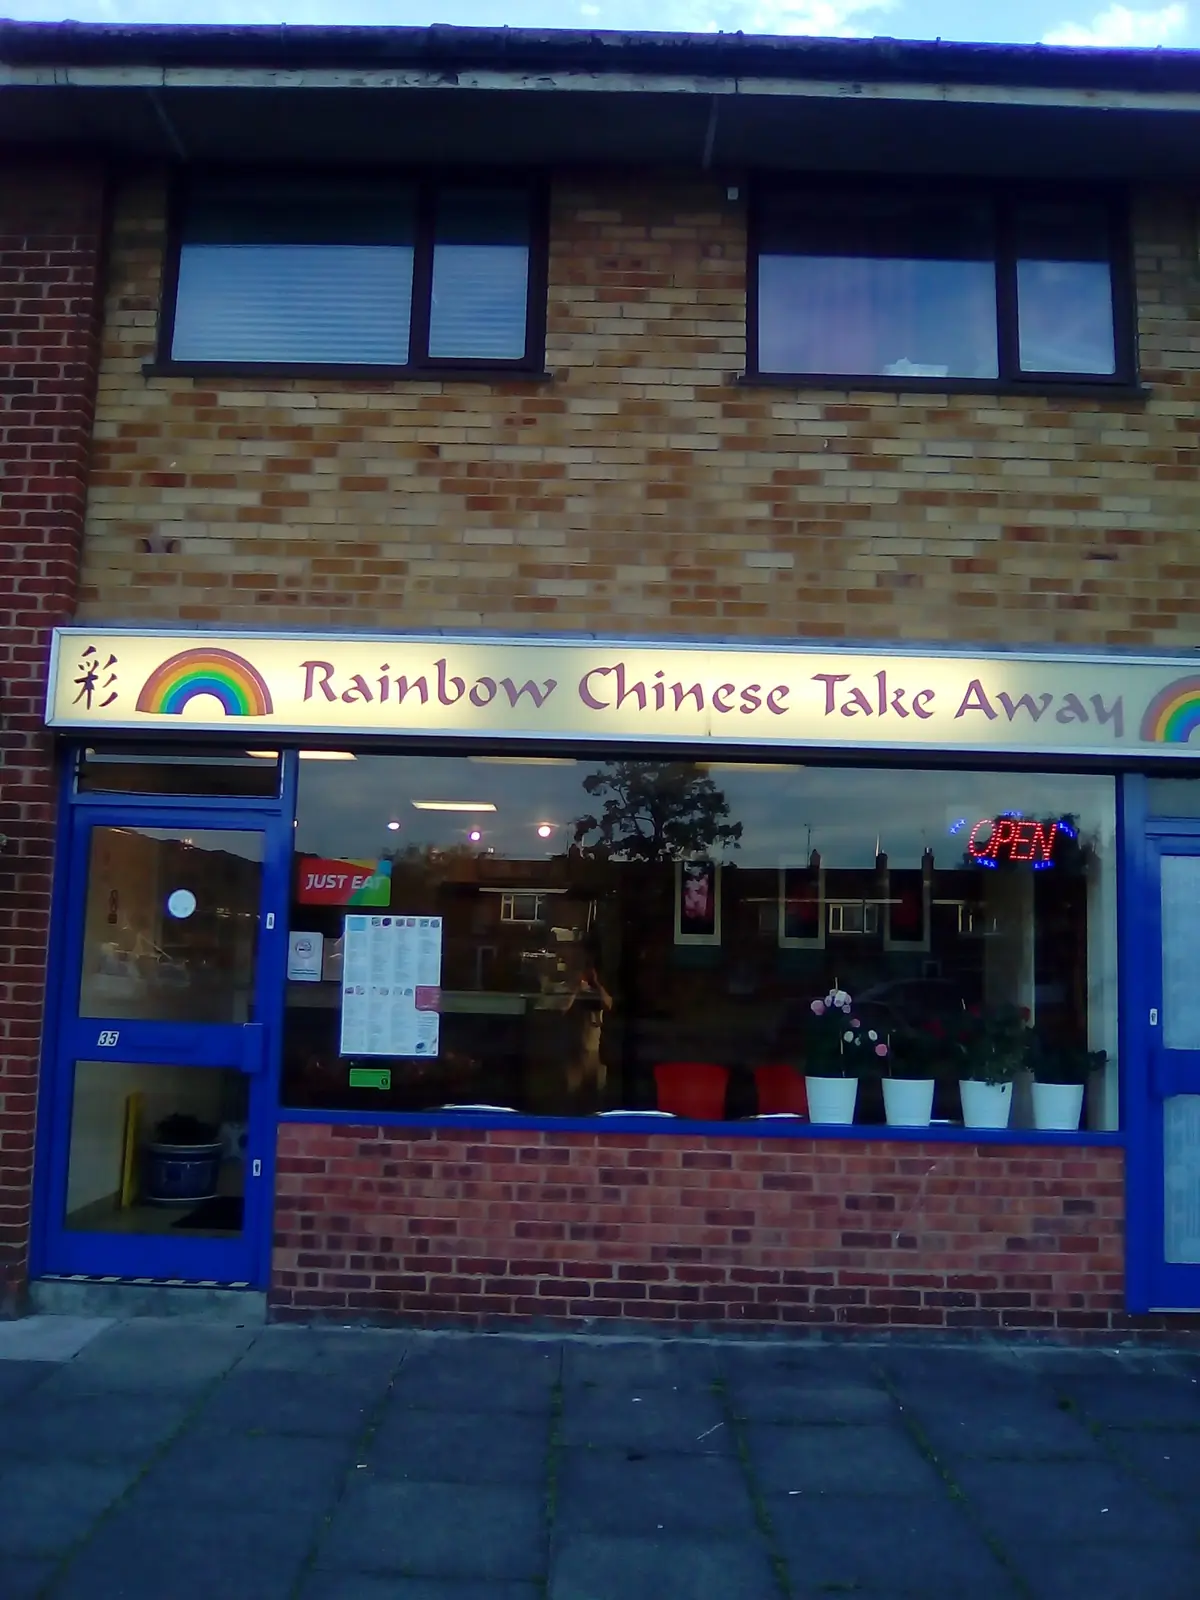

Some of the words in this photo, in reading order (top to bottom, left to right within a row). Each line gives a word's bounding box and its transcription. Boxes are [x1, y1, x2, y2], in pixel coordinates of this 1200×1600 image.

[72, 646, 118, 711] 彩
[299, 659, 557, 709] Rainbow
[578, 662, 790, 716] Chinese
[811, 670, 936, 720] Take
[955, 679, 1124, 738] Away
[968, 818, 1058, 861] OPEN
[305, 873, 348, 890] JUST
[351, 874, 384, 890] EAT
[99, 1032, 118, 1045] 35
